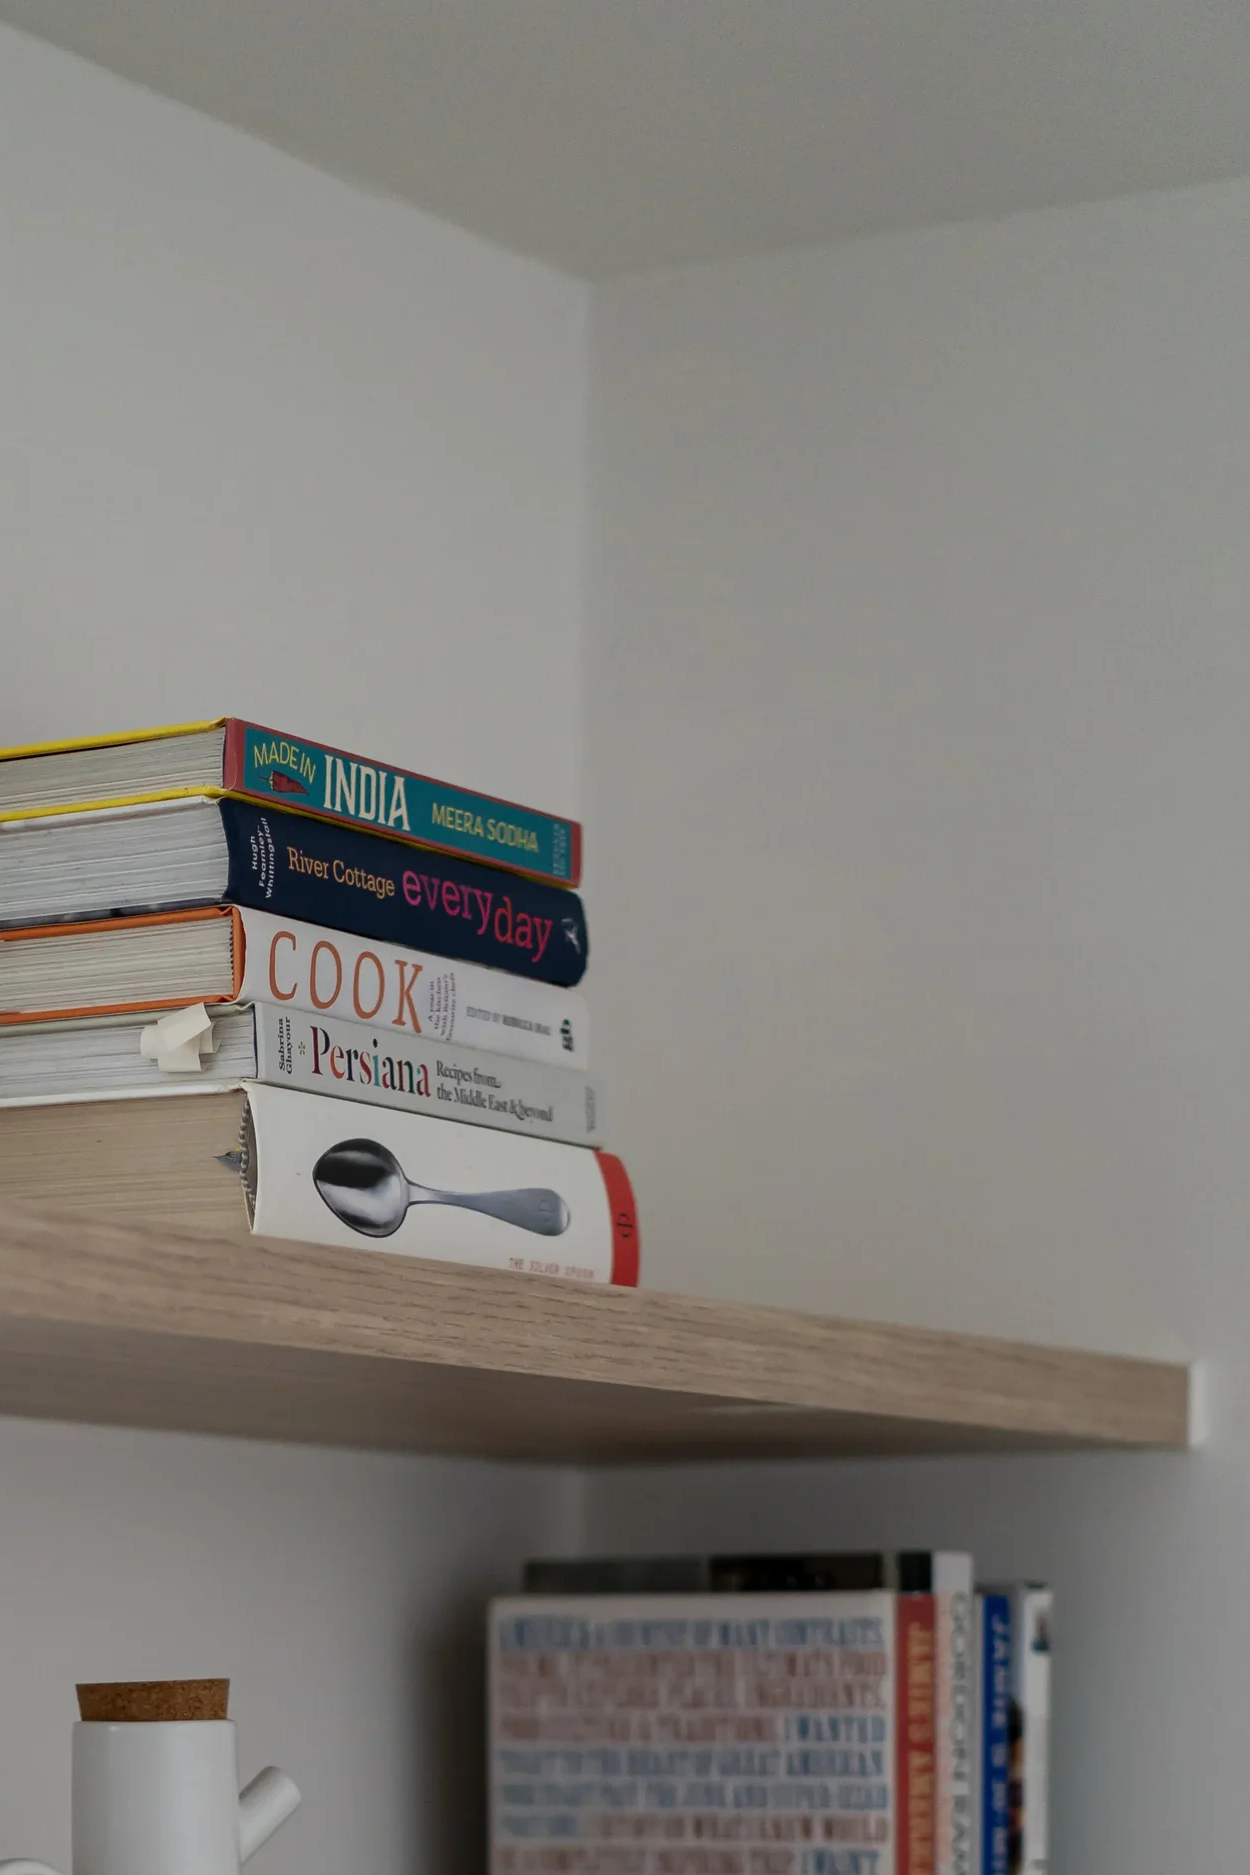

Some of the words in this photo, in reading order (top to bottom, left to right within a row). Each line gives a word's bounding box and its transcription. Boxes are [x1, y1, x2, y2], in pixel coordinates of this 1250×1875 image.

[254, 741, 299, 769] MADE
[299, 752, 316, 785] IN
[323, 754, 411, 832] INDIA
[250, 835, 258, 870] Hugh
[431, 803, 485, 838] MEERA
[486, 819, 539, 853] SODHA
[257, 825, 265, 888] Fearnley-
[261, 817, 275, 899] Whittingstall
[286, 846, 330, 880] River
[333, 859, 396, 900] Cottage
[402, 870, 553, 963] everyday
[269, 931, 423, 1034] COOK
[278, 1018, 286, 1071] Sabrina
[285, 1016, 294, 1074] Ghayour
[310, 1025, 432, 1097] Persiana
[436, 1060, 472, 1085] Recipes
[473, 1068, 502, 1088] from
[436, 1083, 452, 1101] the
[453, 1087, 487, 1109] Middle
[488, 1094, 508, 1113] East
